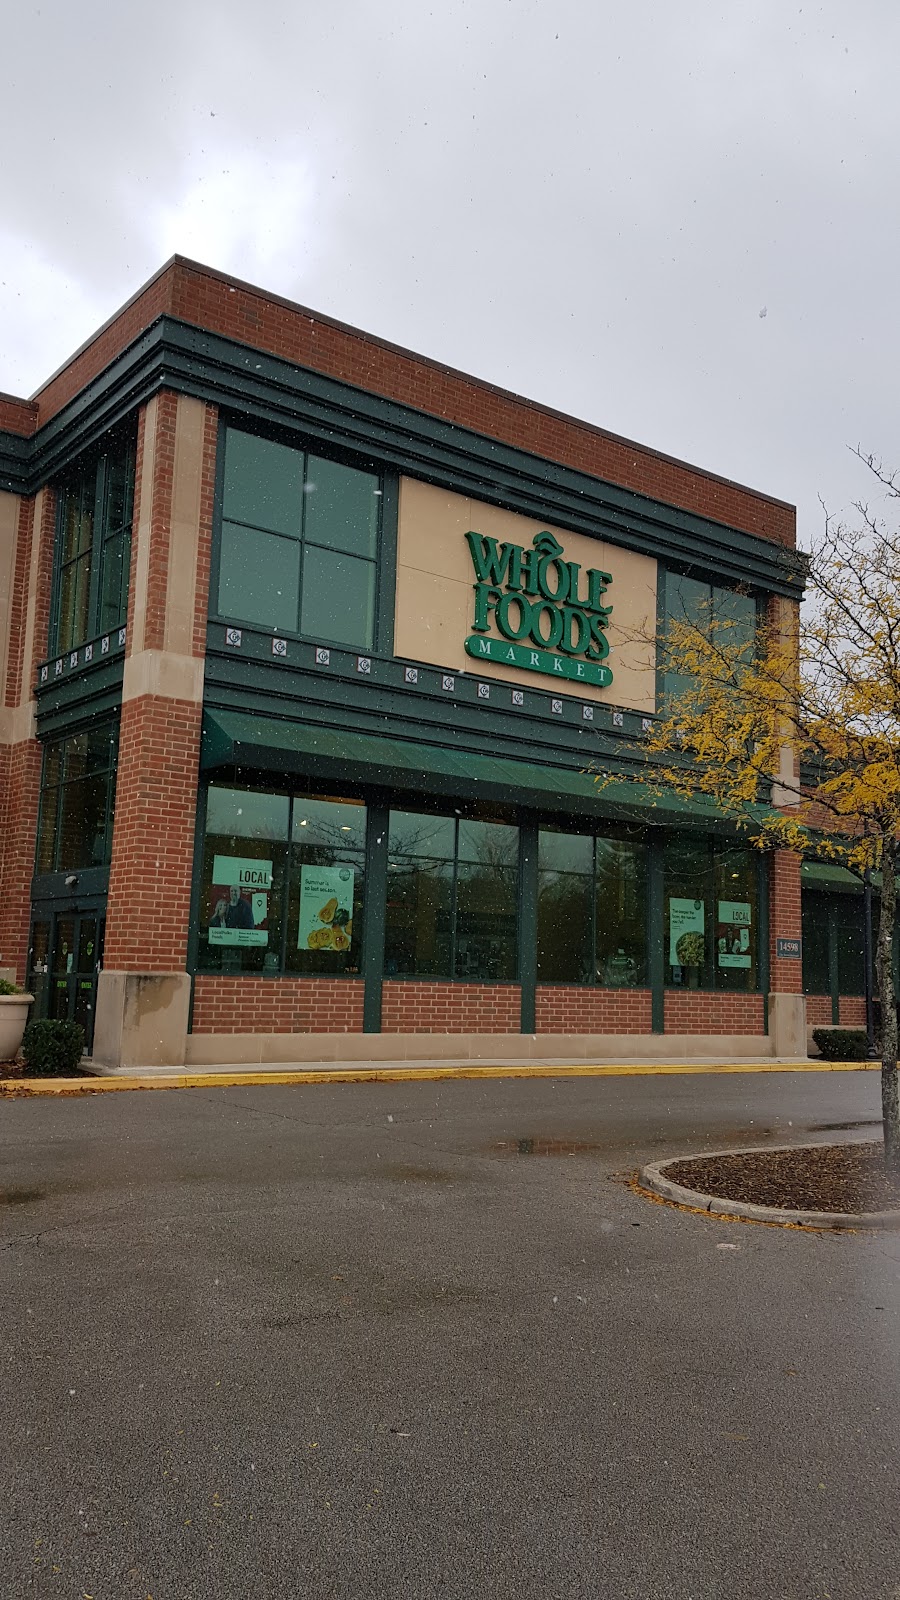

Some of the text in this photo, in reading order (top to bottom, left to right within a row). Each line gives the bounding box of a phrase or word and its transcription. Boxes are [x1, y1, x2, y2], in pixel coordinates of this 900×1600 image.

[464, 531, 613, 615] WHOLE
[471, 582, 610, 661] FOODS
[479, 639, 607, 682] MARKET
[239, 869, 269, 884] LOCAL
[732, 911, 750, 922] LOCAL
[779, 941, 799, 953] 14598
